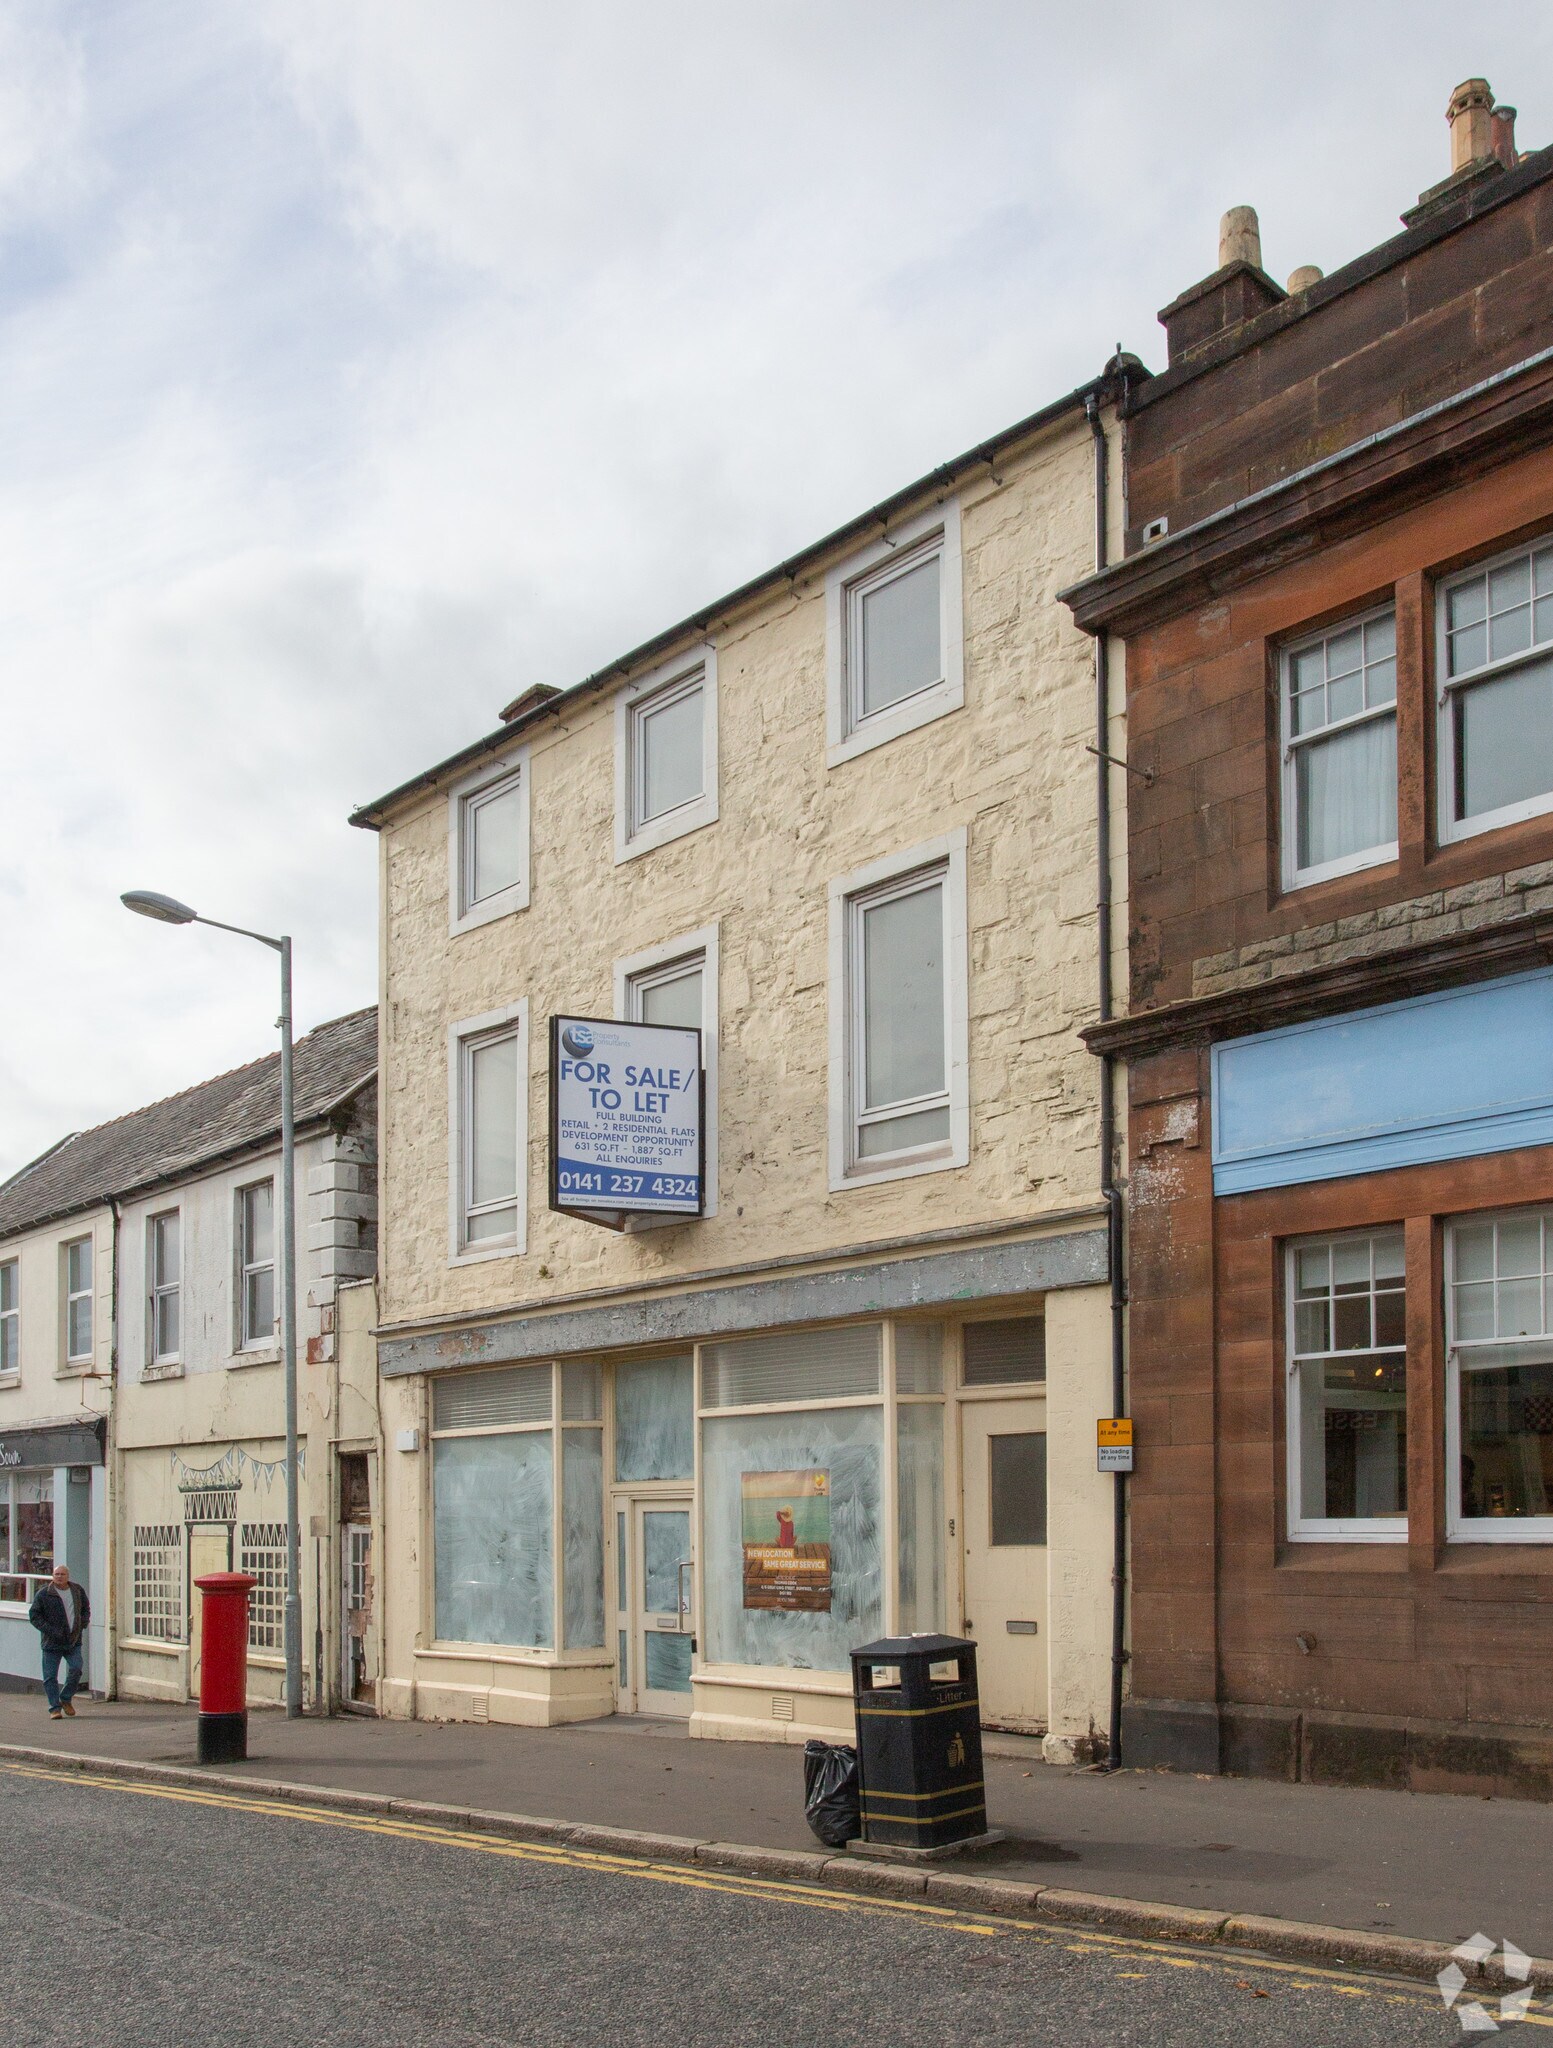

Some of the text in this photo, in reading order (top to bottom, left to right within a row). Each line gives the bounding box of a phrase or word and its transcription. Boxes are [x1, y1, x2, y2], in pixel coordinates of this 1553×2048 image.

[592, 1031, 620, 1041] Property
[592, 1037, 631, 1048] Consultants
[561, 1060, 695, 1093] FOR SALE/
[588, 1087, 670, 1114] TO LET
[596, 1111, 662, 1124] FULL BUILDING
[561, 1119, 696, 1137] RETAIL 2 RESIDENTIAL FLATS
[562, 1130, 695, 1147] DEVELOPMENT OPPORTUNITY
[574, 1141, 590, 1151] 631
[594, 1142, 620, 1152] SQ.FT
[632, 1145, 654, 1155] 1,887
[658, 1147, 683, 1157] SQ.FT
[596, 1153, 663, 1166] ALL ENQUIRIES
[559, 1171, 698, 1197] 0141 237 4324
[747, 1549, 793, 1558] NEW LOCATION
[763, 1560, 825, 1569] SAME GREAT SERVICE
[940, 1690, 962, 1703] Litter
